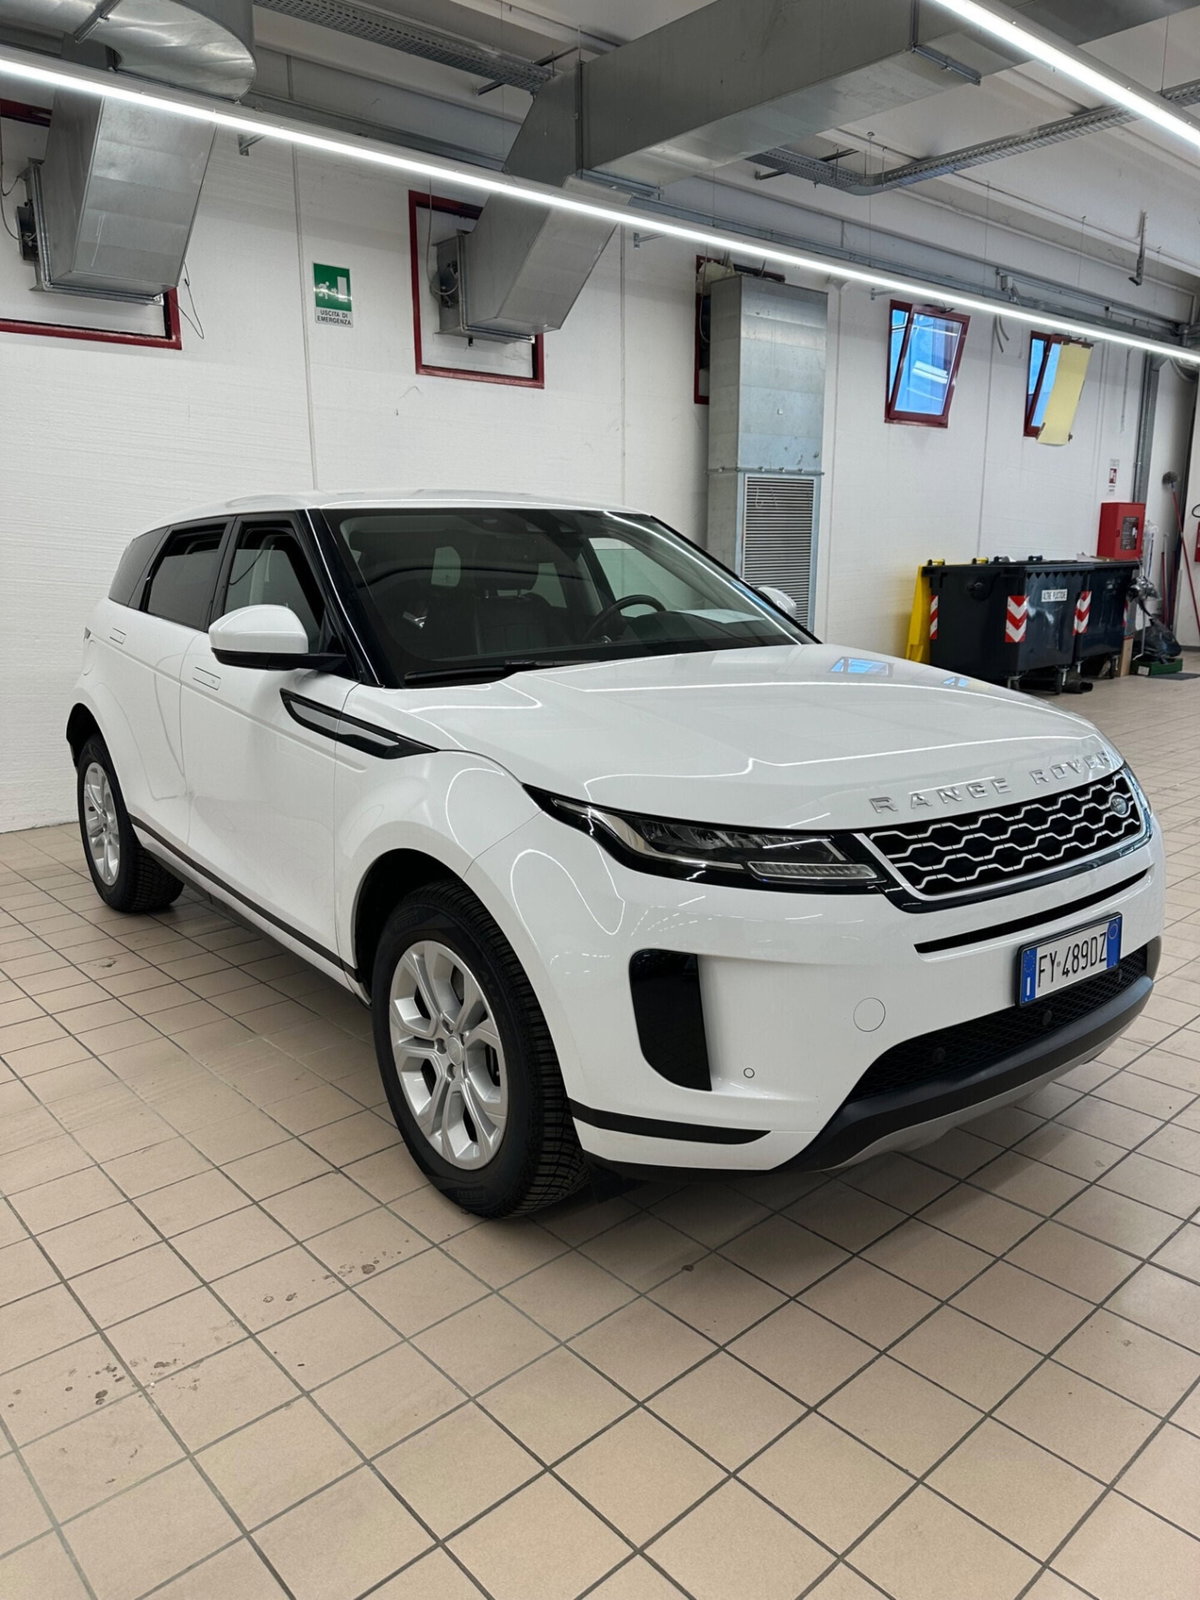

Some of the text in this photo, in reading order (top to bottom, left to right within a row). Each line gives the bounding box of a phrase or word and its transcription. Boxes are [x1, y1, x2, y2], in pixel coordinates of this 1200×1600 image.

[320, 309, 340, 317] USCITA
[317, 315, 352, 325] EMERGENZA
[869, 751, 1111, 814] RANGE ROVER
